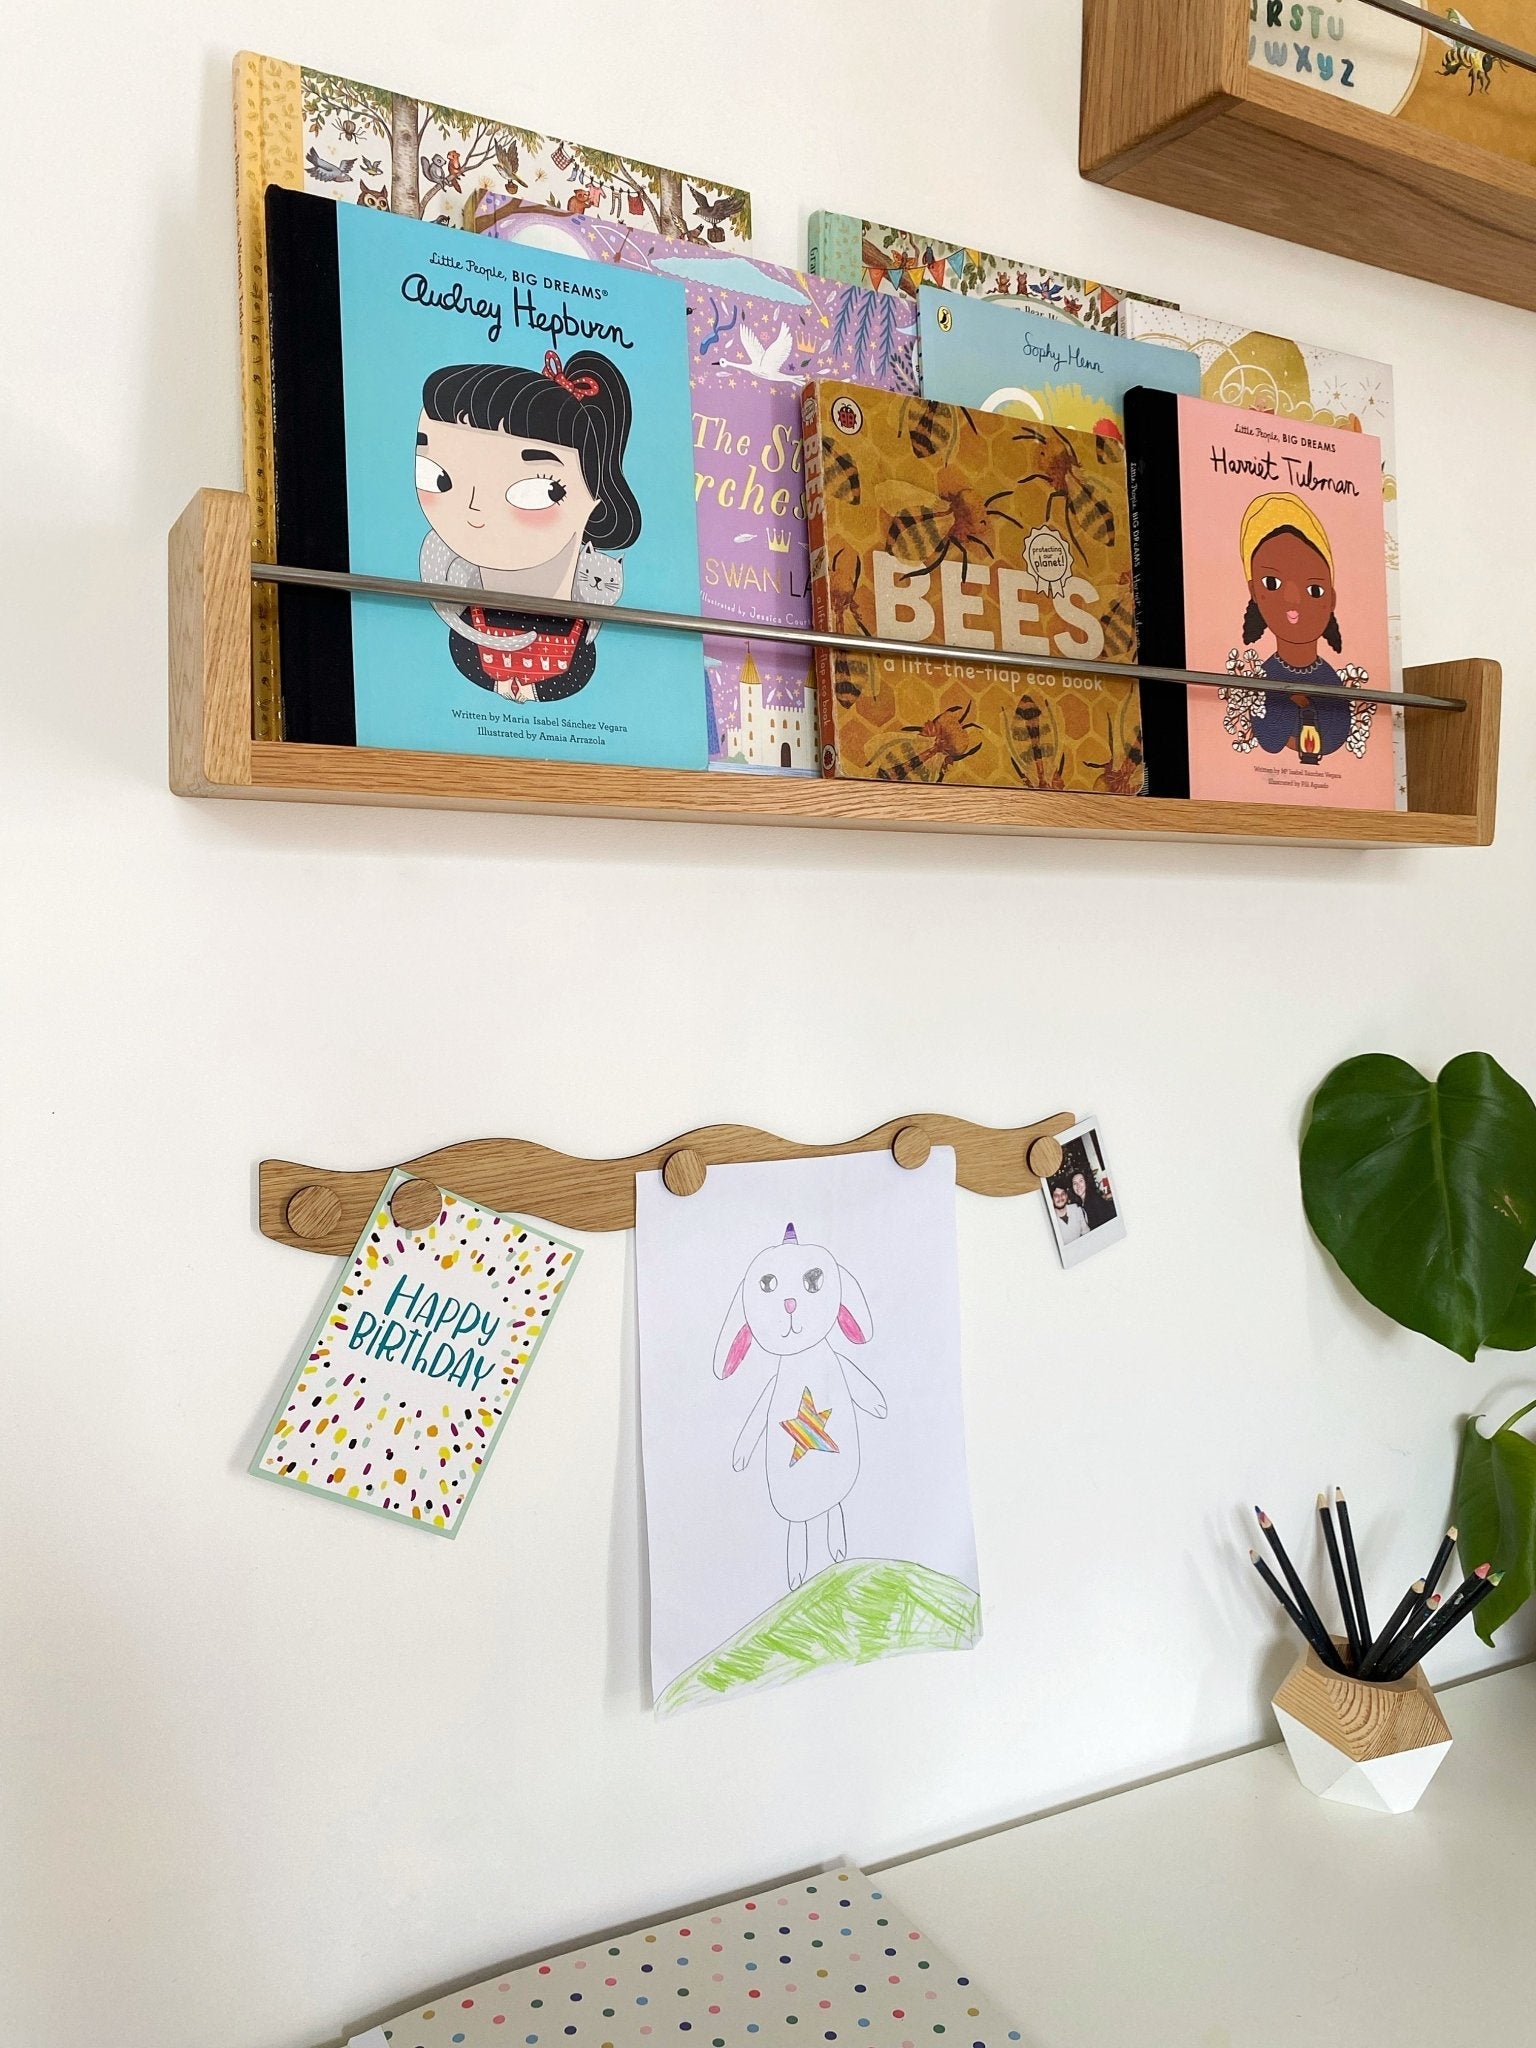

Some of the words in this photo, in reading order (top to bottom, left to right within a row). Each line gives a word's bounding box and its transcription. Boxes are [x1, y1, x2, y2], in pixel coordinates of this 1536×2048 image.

[429, 252, 463, 269] Little
[466, 259, 507, 281] People,
[512, 270, 538, 286] BIG
[401, 273, 502, 342] Audrey
[514, 286, 634, 350] Hepburn
[1023, 331, 1068, 372] Sophy
[1068, 344, 1104, 374] Henn
[692, 412, 751, 456] The
[1234, 423, 1255, 436] Little
[1256, 428, 1280, 443] People,
[1282, 433, 1298, 445] BIG
[1301, 437, 1336, 453] DREAMS
[803, 433, 824, 521] BEES
[1210, 445, 1280, 481] Harriet
[1281, 456, 1360, 497] Tubman
[1032, 546, 1063, 556] protecting
[1034, 555, 1065, 573] planet!
[704, 557, 782, 594] SWAN
[738, 605, 746, 617] by
[750, 606, 782, 624] Jessica
[872, 551, 1106, 662] BEES
[883, 656, 896, 672] a
[1026, 671, 1057, 688] eco
[1062, 671, 1104, 692] book
[451, 709, 488, 721] Written
[489, 711, 501, 724] by
[533, 716, 560, 727] Isabel
[561, 718, 597, 730] Sánchez
[598, 721, 628, 733] Vegara
[822, 700, 831, 727] book
[477, 726, 524, 739] Illustrated
[526, 730, 537, 742] by
[538, 731, 568, 743] Amaia
[569, 733, 606, 746] Arrazola
